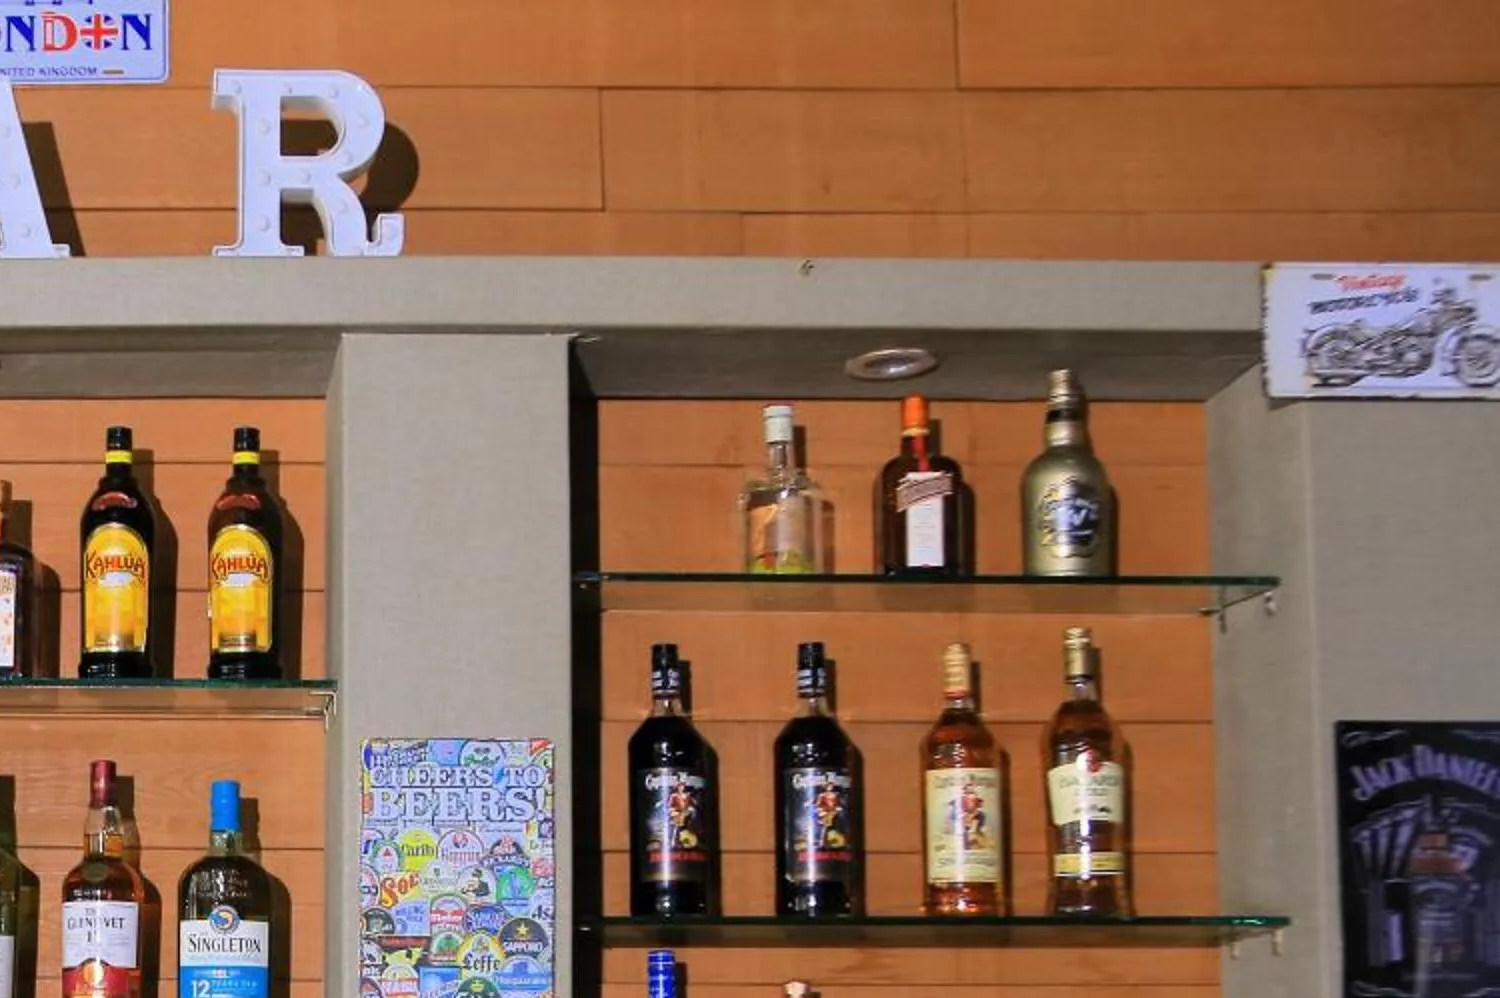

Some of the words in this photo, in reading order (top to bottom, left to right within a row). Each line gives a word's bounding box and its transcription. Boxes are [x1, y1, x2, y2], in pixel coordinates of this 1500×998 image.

[39, 66, 98, 77] KINGDOM
[369, 765, 494, 787] CHEERS
[505, 765, 546, 787] TO
[371, 787, 546, 822] BEERS!
[187, 936, 262, 953] SINGLETON
[191, 979, 211, 998] 12
